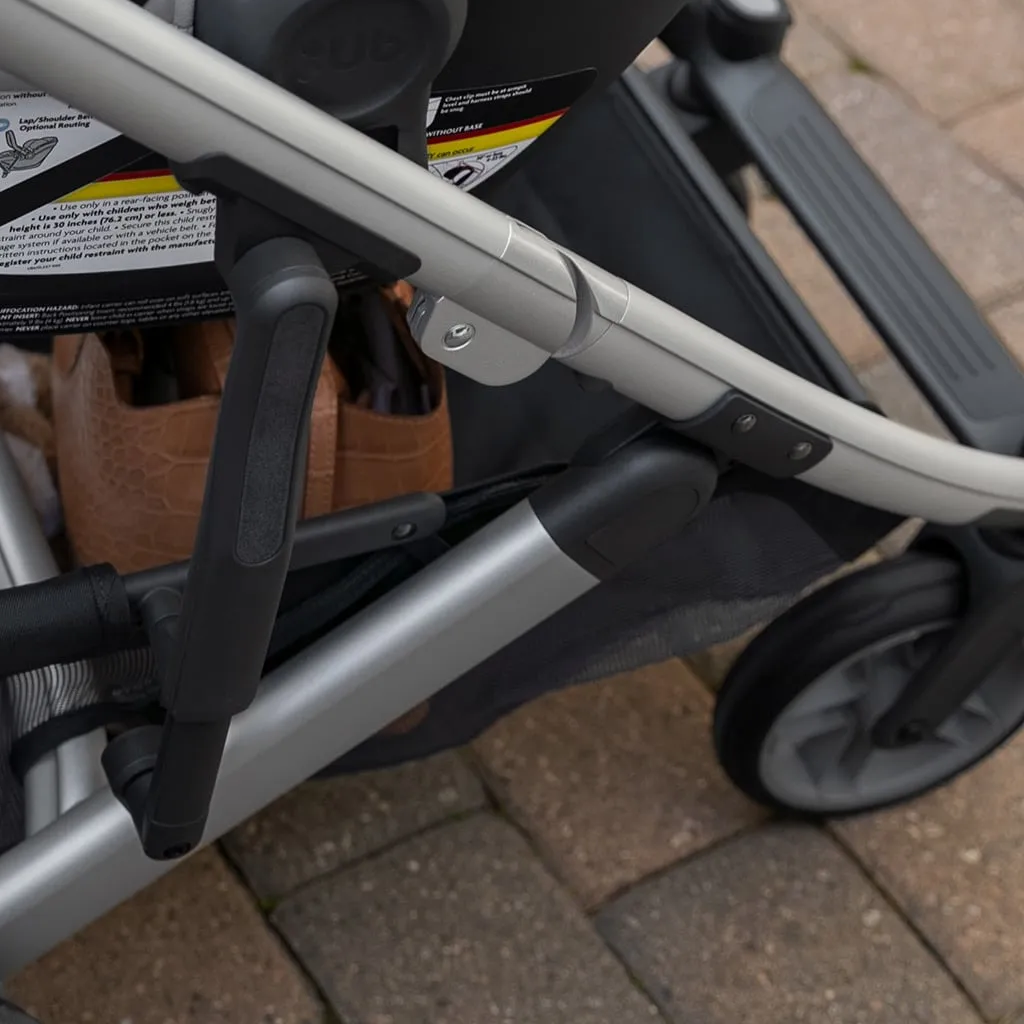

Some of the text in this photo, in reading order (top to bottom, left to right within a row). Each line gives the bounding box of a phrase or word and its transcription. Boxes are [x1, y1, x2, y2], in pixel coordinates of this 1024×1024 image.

[19, 114, 76, 124] Lap/Shoulder
[19, 123, 56, 132] Optional
[426, 123, 483, 137] WITHOUT BASE
[59, 212, 80, 220] only
[82, 210, 103, 218] with
[106, 206, 145, 215] children
[171, 199, 197, 208] weigh
[80, 201, 100, 209] only
[120, 194, 169, 205] rear-facing
[9, 223, 40, 233] height
[67, 218, 97, 227] inches
[100, 216, 122, 225] (76.2
[124, 214, 143, 222] cm)
[187, 206, 215, 215] Snugly
[28, 231, 62, 239] around
[64, 227, 86, 238] your
[88, 225, 112, 233] child.
[121, 221, 153, 231] Secure
[154, 218, 170, 226] this
[172, 216, 194, 224] child
[18, 241, 50, 251] system
[52, 237, 59, 245] if
[61, 234, 101, 245] available
[116, 231, 136, 239] with
[146, 225, 177, 235] vehicle
[27, 245, 81, 256] instructions
[83, 241, 118, 251] located
[131, 237, 146, 245] the
[148, 234, 180, 245] pocket
[34, 254, 58, 264] your
[58, 252, 82, 261] child
[84, 248, 125, 258] restraint
[128, 245, 149, 253] with
[151, 243, 167, 251] the
